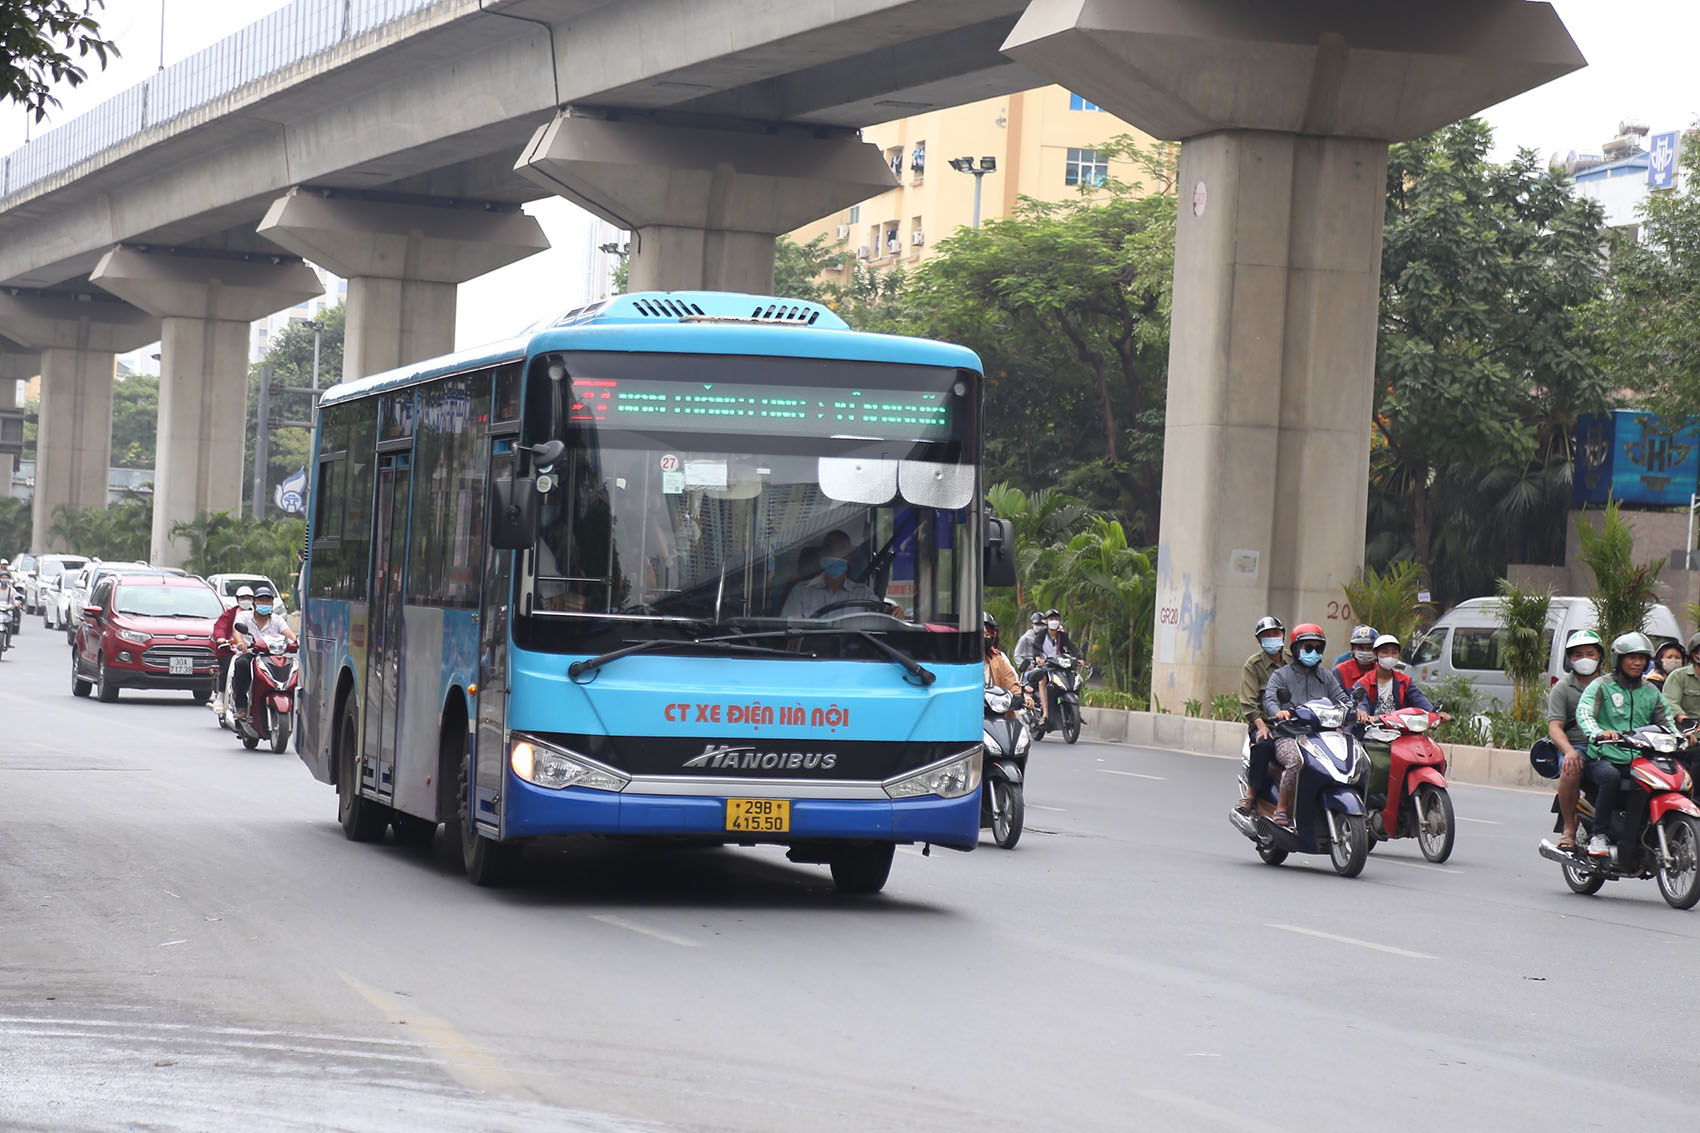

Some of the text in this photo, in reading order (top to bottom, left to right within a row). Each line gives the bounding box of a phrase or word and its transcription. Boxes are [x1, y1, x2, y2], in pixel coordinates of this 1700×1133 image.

[662, 457, 676, 469] 27
[1160, 607, 1178, 625] GR20
[1327, 600, 1351, 620] 20
[664, 701, 849, 733] CT XE ĐIỆN HÀ NỘI
[744, 801, 773, 814] 29B
[732, 816, 783, 830] 415.50
